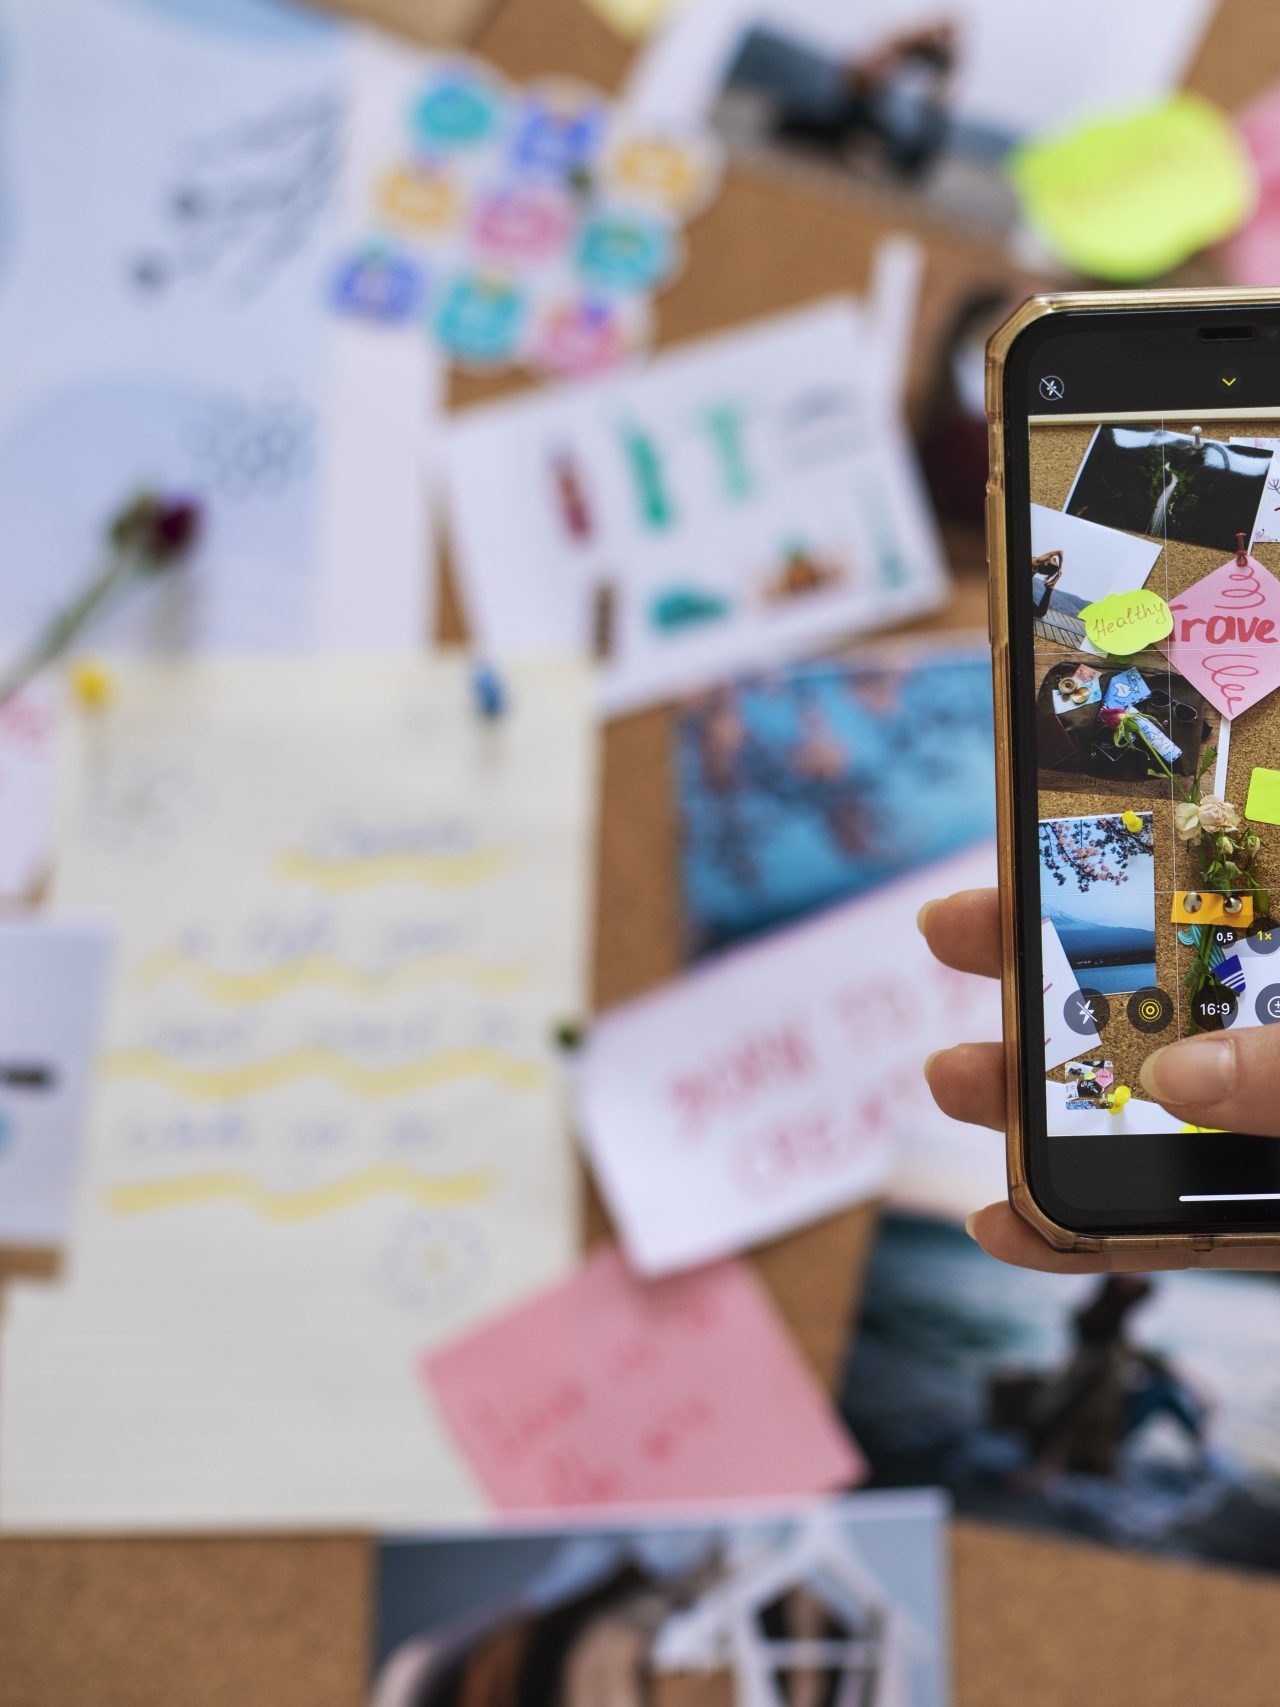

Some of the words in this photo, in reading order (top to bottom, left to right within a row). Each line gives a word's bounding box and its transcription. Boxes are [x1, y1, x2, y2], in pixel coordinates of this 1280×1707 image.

[1093, 602, 1166, 642] Healthy
[1216, 932, 1234, 944] 0,5
[1199, 1002, 1231, 1016] 16:9
